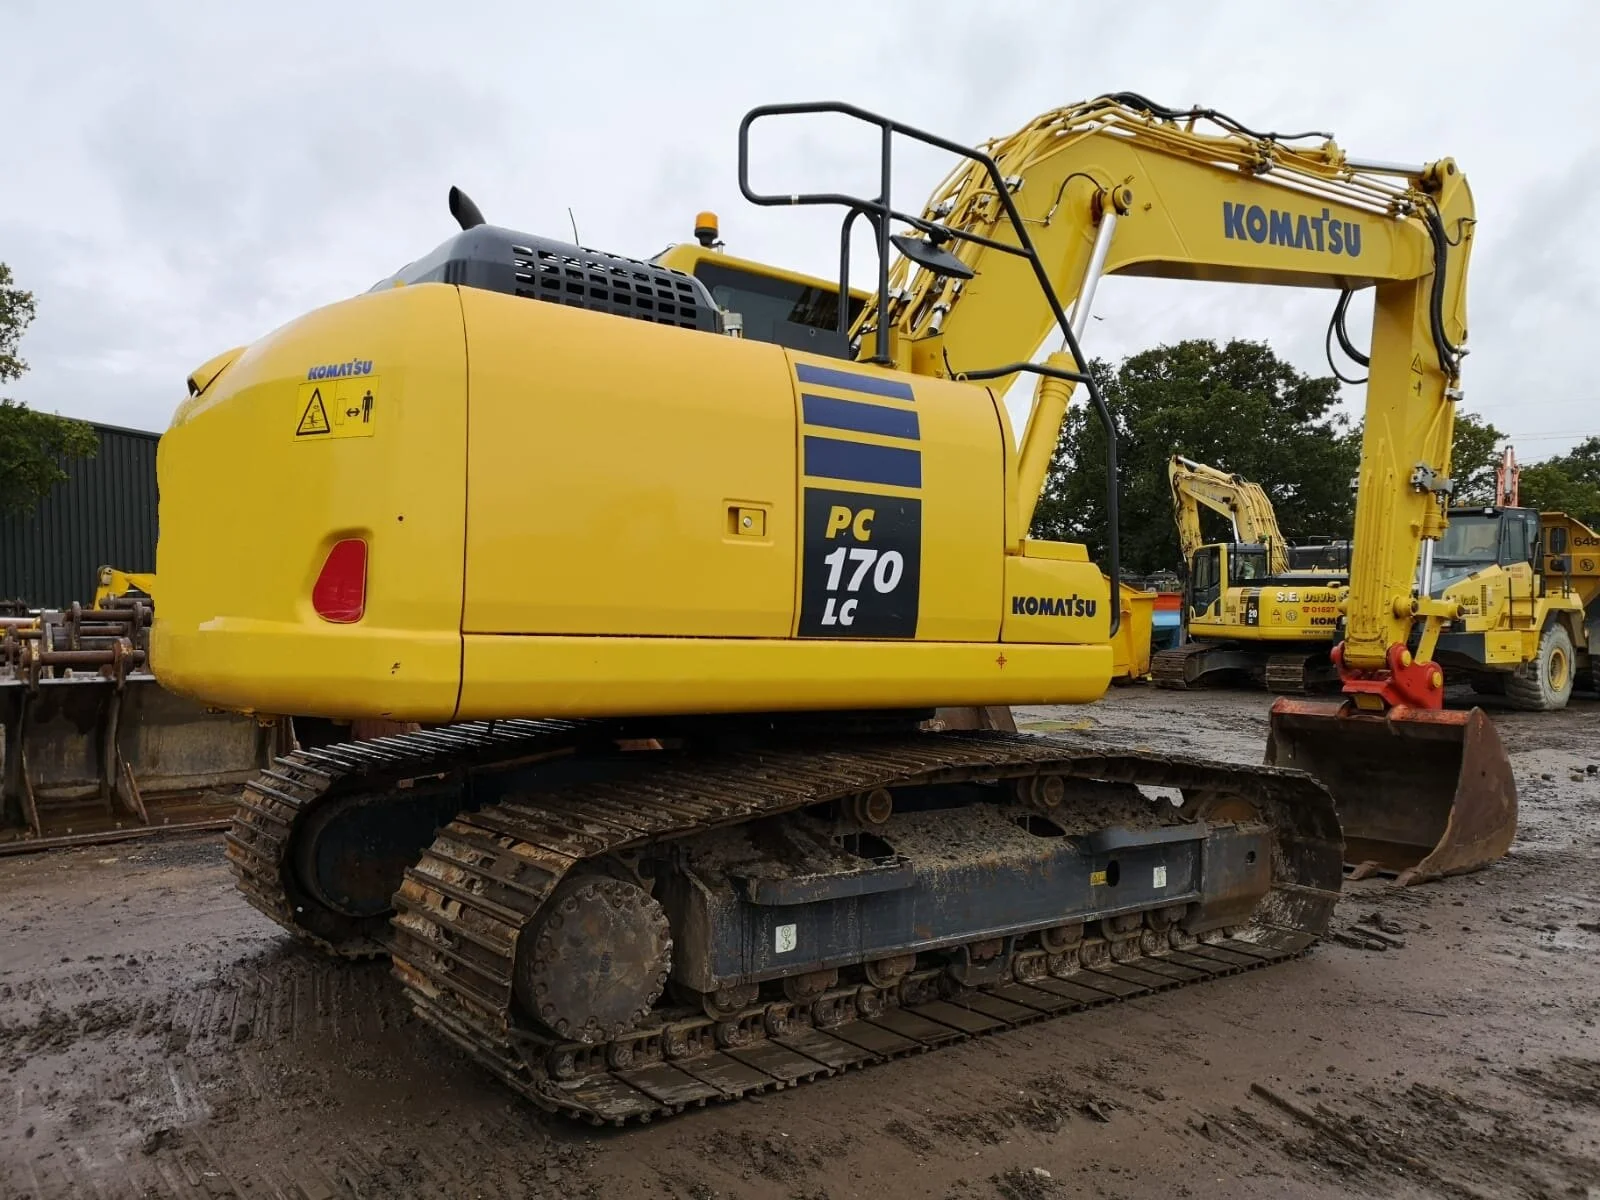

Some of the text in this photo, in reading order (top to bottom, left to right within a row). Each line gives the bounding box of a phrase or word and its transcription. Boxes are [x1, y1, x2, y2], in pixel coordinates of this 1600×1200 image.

[1223, 201, 1362, 257] KOMATSU
[307, 357, 373, 380] KOMATSU
[825, 505, 875, 541] PC
[824, 547, 904, 593] 170
[821, 598, 858, 626] LC
[1012, 594, 1096, 617] KOMATSU
